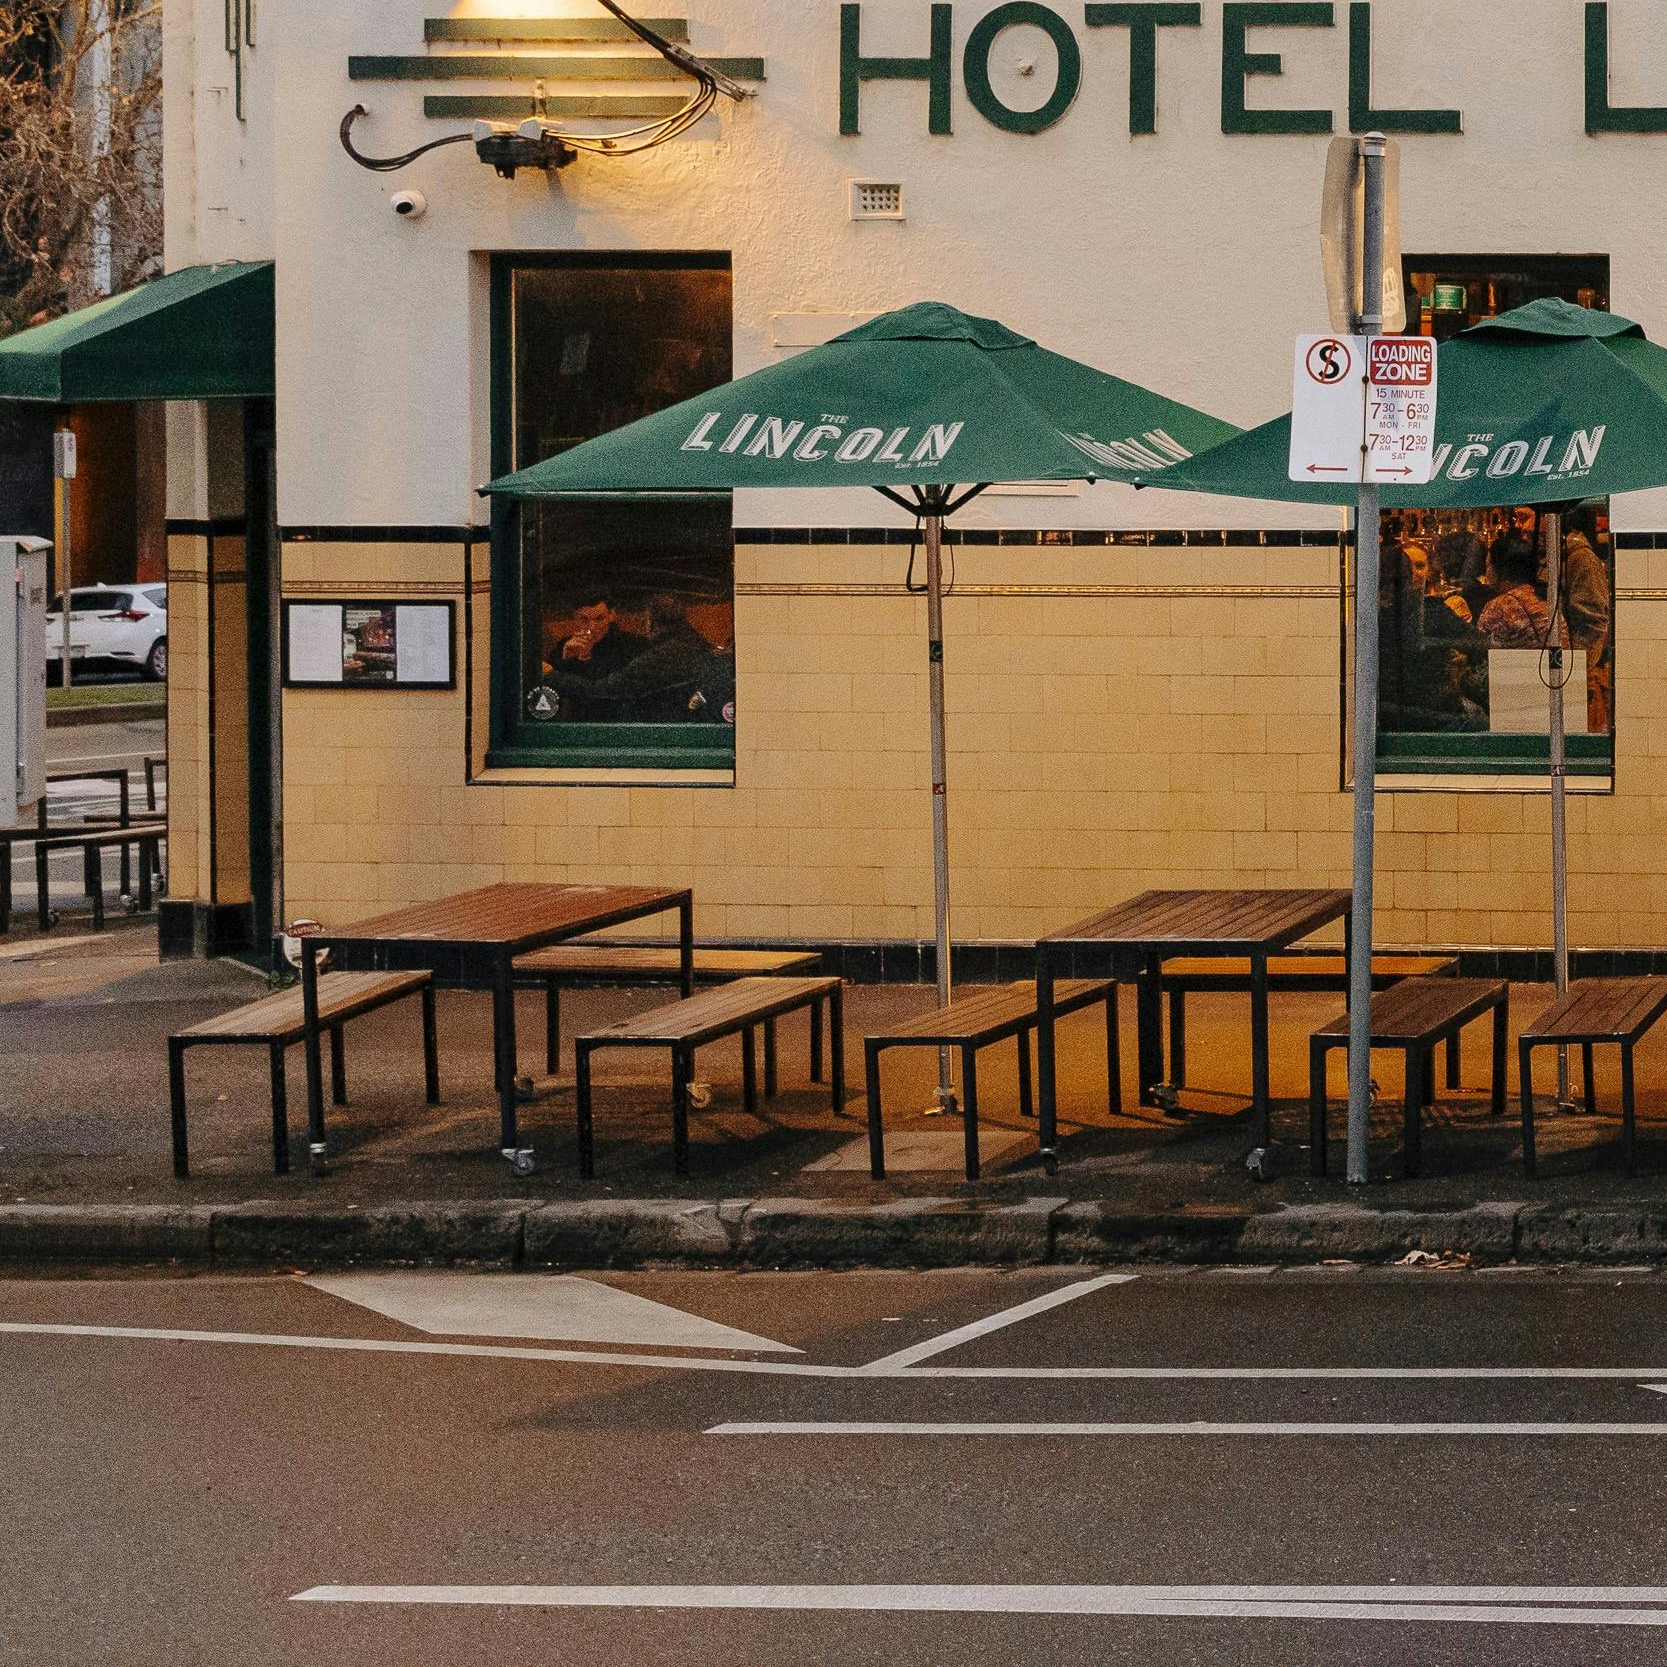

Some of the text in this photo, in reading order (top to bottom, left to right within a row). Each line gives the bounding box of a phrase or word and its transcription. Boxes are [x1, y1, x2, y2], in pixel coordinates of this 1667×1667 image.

[839, 0, 1462, 134] HOTEL
[1371, 344, 1431, 363] LOADING
[1374, 363, 1427, 381] ZONE
[1376, 388, 1425, 399] 15 MINUTE
[820, 414, 849, 424] THE
[1379, 421, 1399, 429] MON
[1408, 421, 1421, 429] FRI
[681, 412, 964, 463] LINCOLN
[1467, 433, 1494, 442] THE
[1391, 452, 1407, 460] SAT
[1429, 425, 1606, 481] COLN
